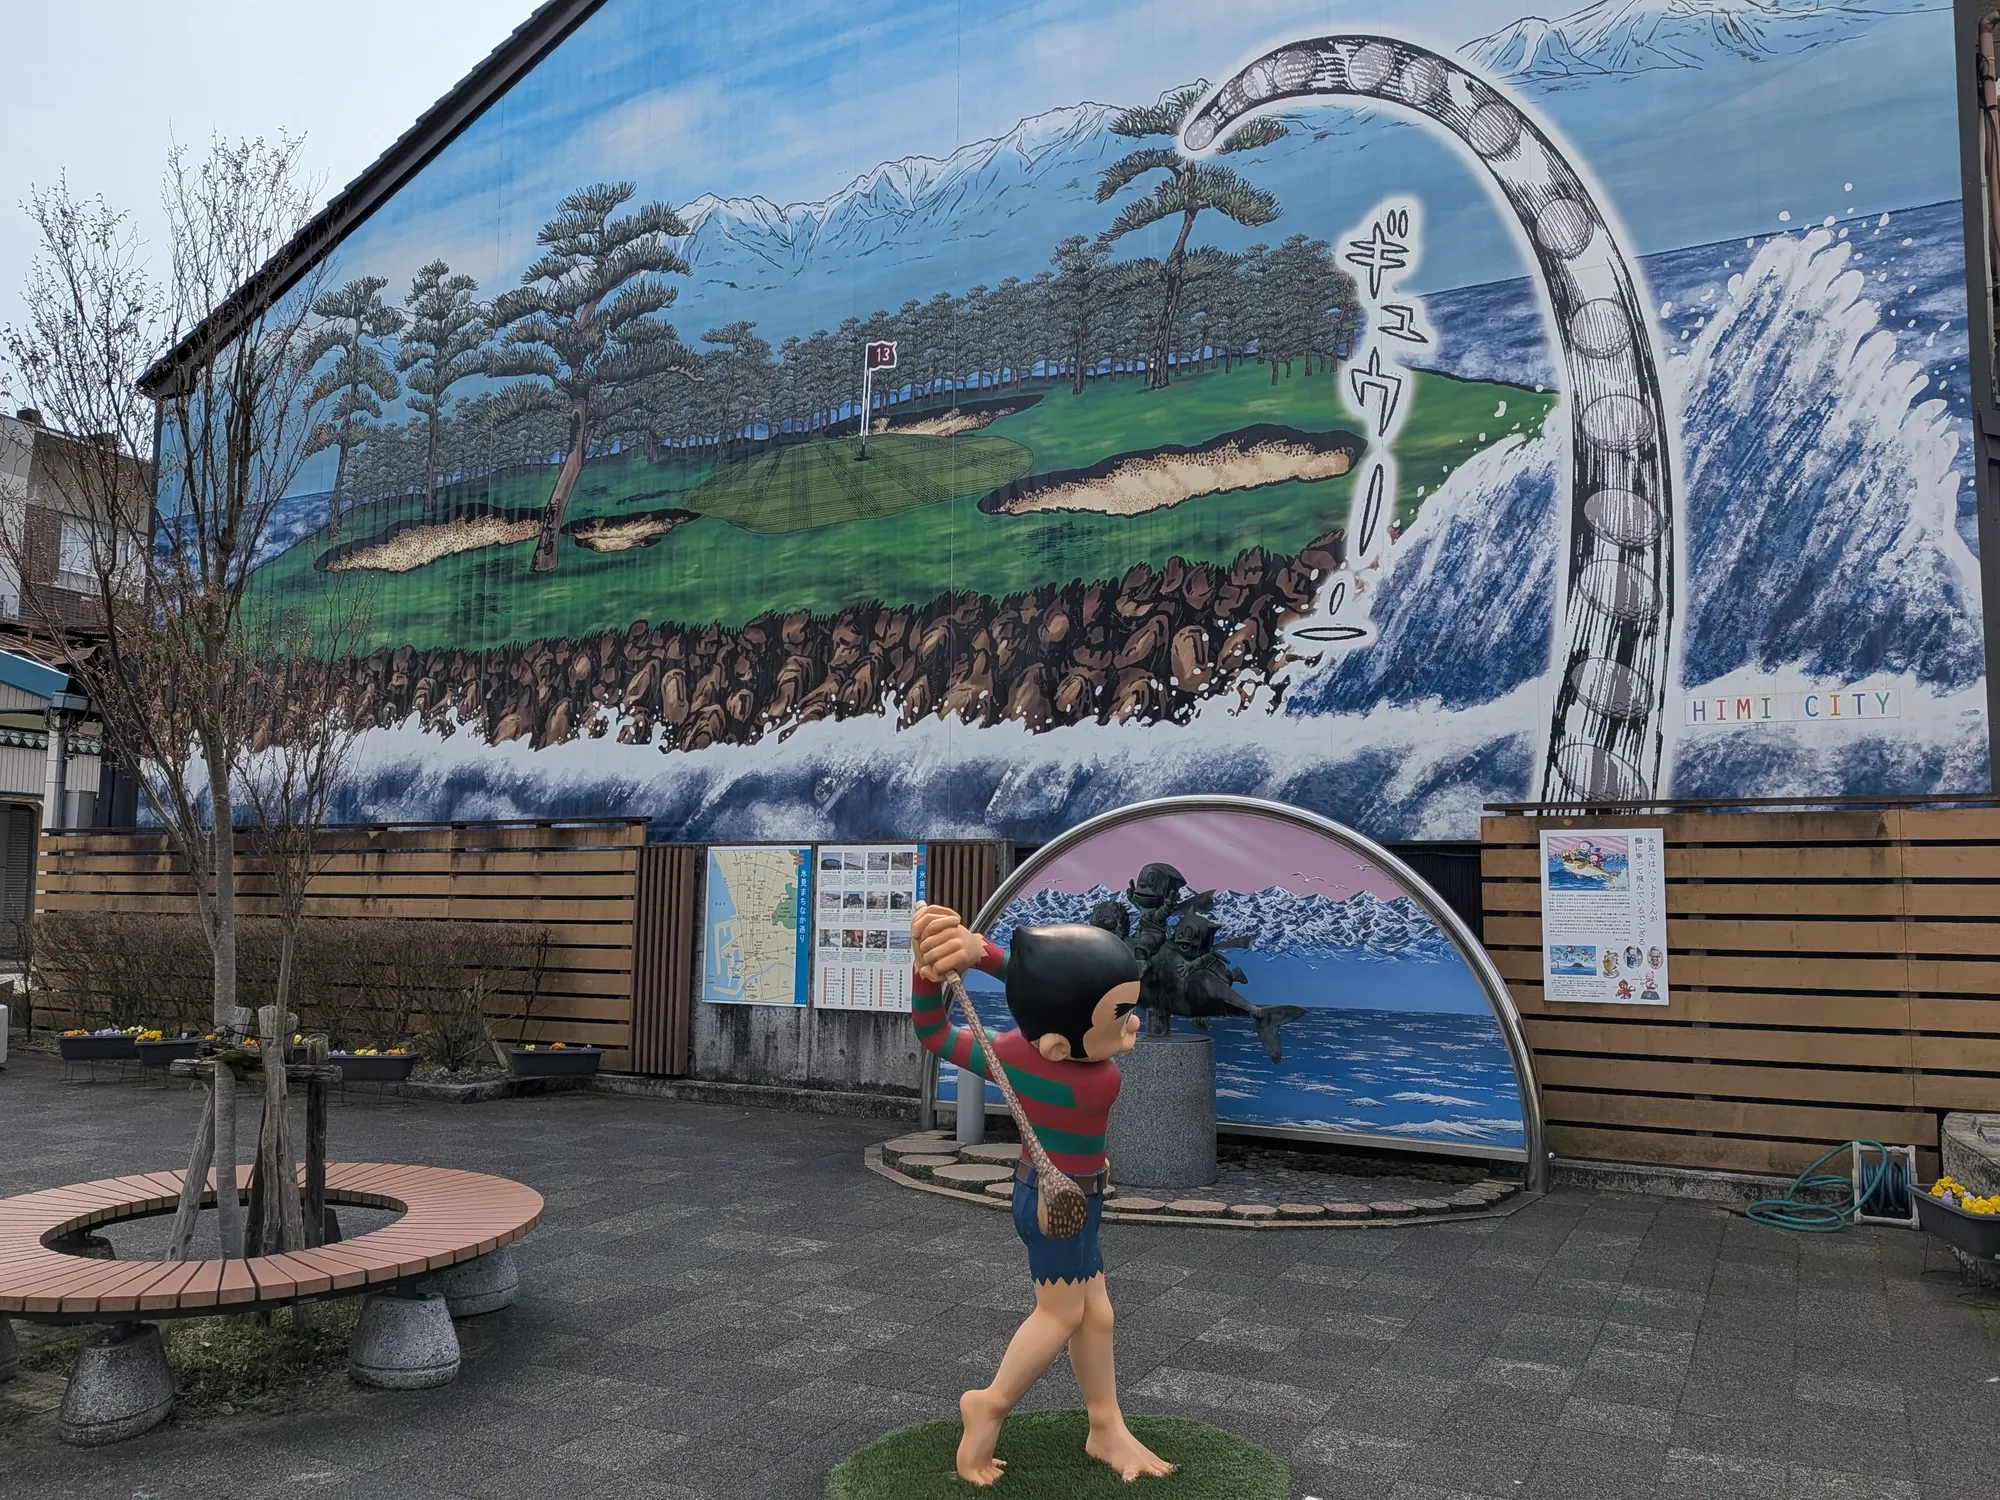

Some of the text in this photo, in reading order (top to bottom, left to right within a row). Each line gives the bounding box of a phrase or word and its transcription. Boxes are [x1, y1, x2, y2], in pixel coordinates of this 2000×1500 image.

[876, 347, 890, 363] 13
[1692, 692, 1891, 722] HIMI CITY
[1647, 836, 1659, 923] 氷見ではハットリくんが
[798, 869, 808, 943] 氷見まちなか巡り
